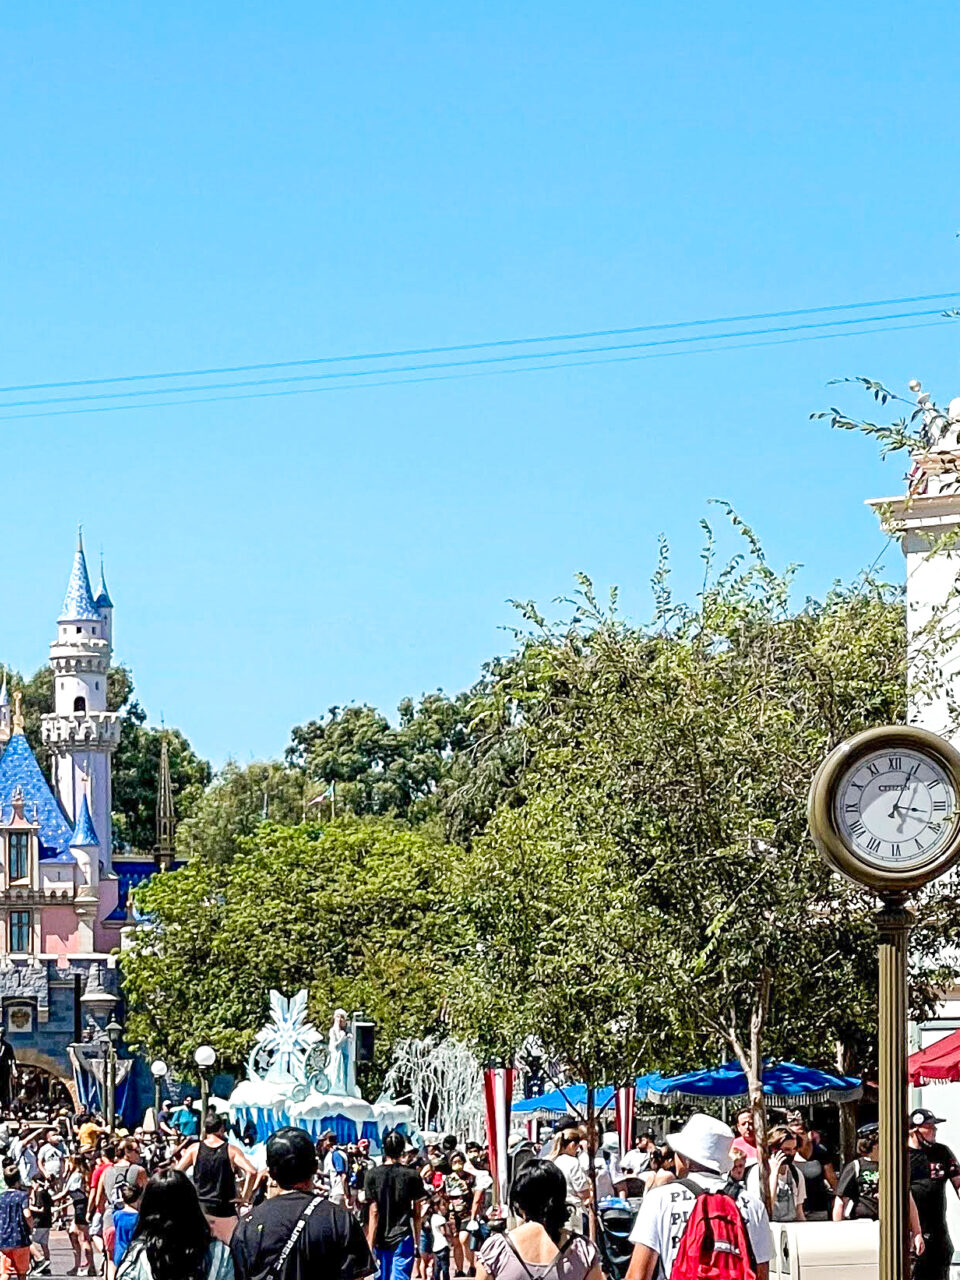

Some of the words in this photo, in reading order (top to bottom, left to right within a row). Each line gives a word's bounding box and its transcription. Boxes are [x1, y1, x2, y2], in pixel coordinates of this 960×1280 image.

[866, 762, 880, 777] XI
[888, 757, 902, 770] XII
[913, 763, 921, 775] I
[851, 780, 864, 791] X
[927, 779, 940, 790] II
[845, 803, 859, 813] IX
[933, 801, 946, 811] III
[849, 820, 867, 839] VIII
[866, 837, 881, 853] VII
[891, 843, 902, 857] VI
[914, 838, 924, 850] V
[273, 1219, 306, 1271] SUPREME
